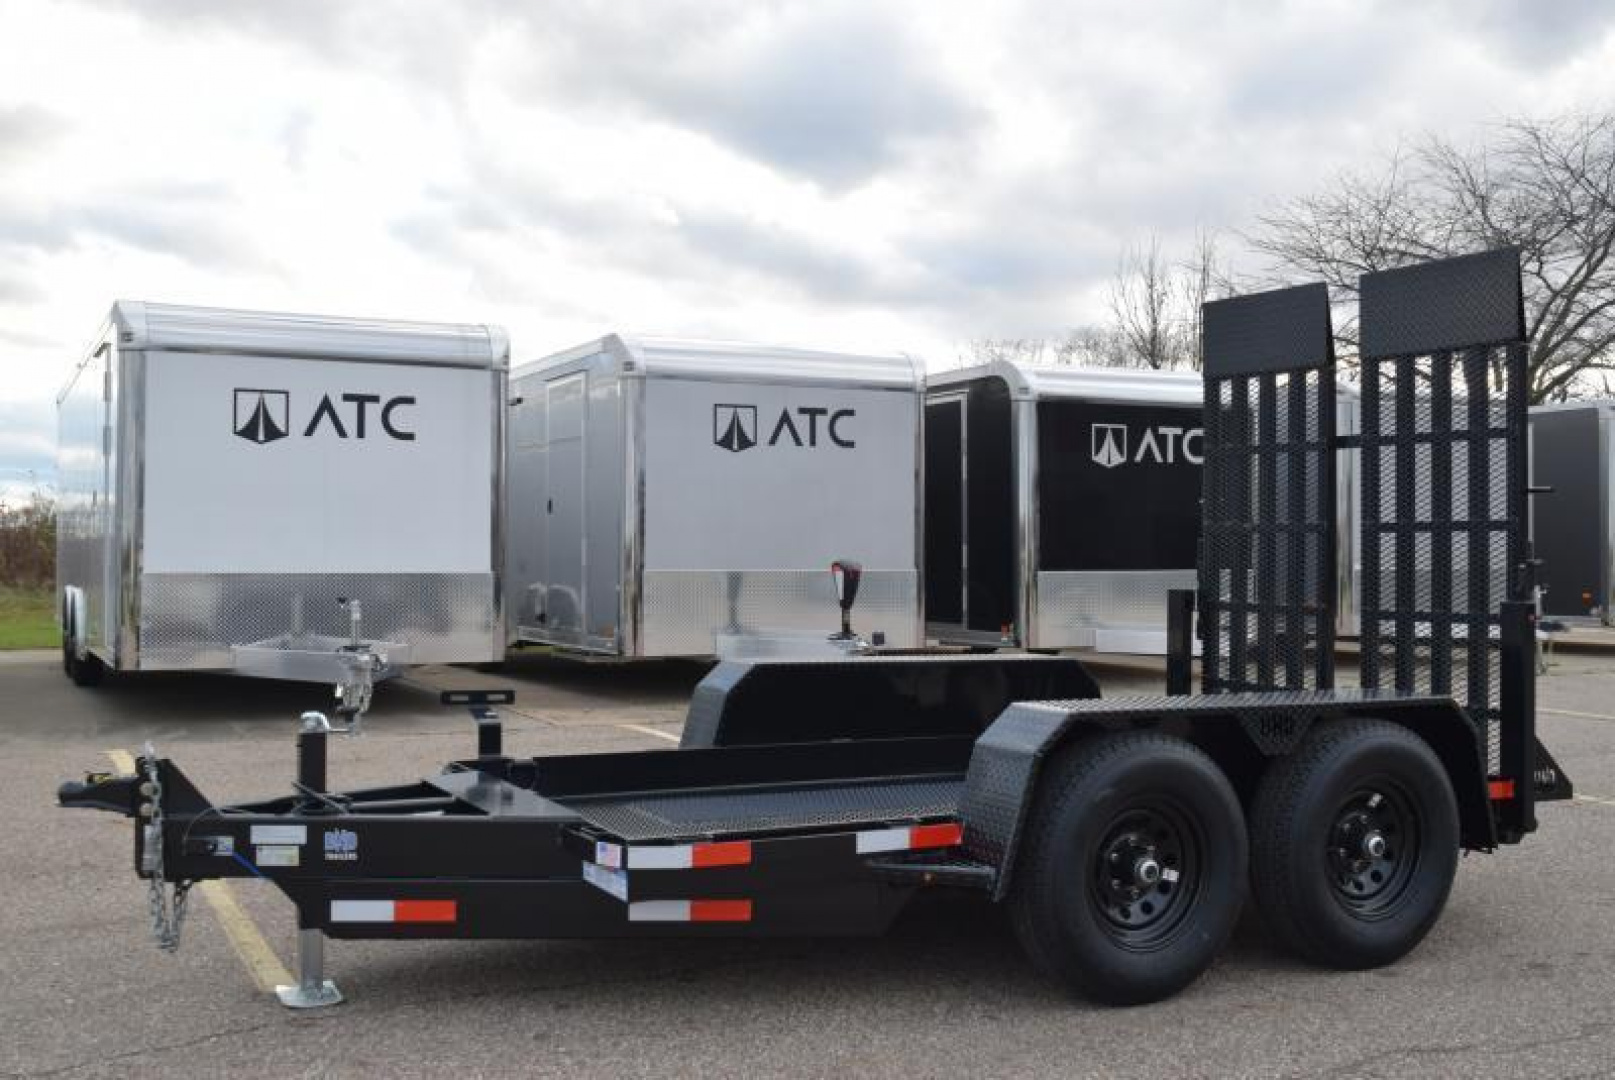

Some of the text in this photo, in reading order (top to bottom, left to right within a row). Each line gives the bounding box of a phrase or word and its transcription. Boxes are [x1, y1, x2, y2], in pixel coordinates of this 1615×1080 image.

[303, 392, 416, 441] ATC
[768, 406, 856, 449] ATC
[1134, 426, 1205, 465] ATC
